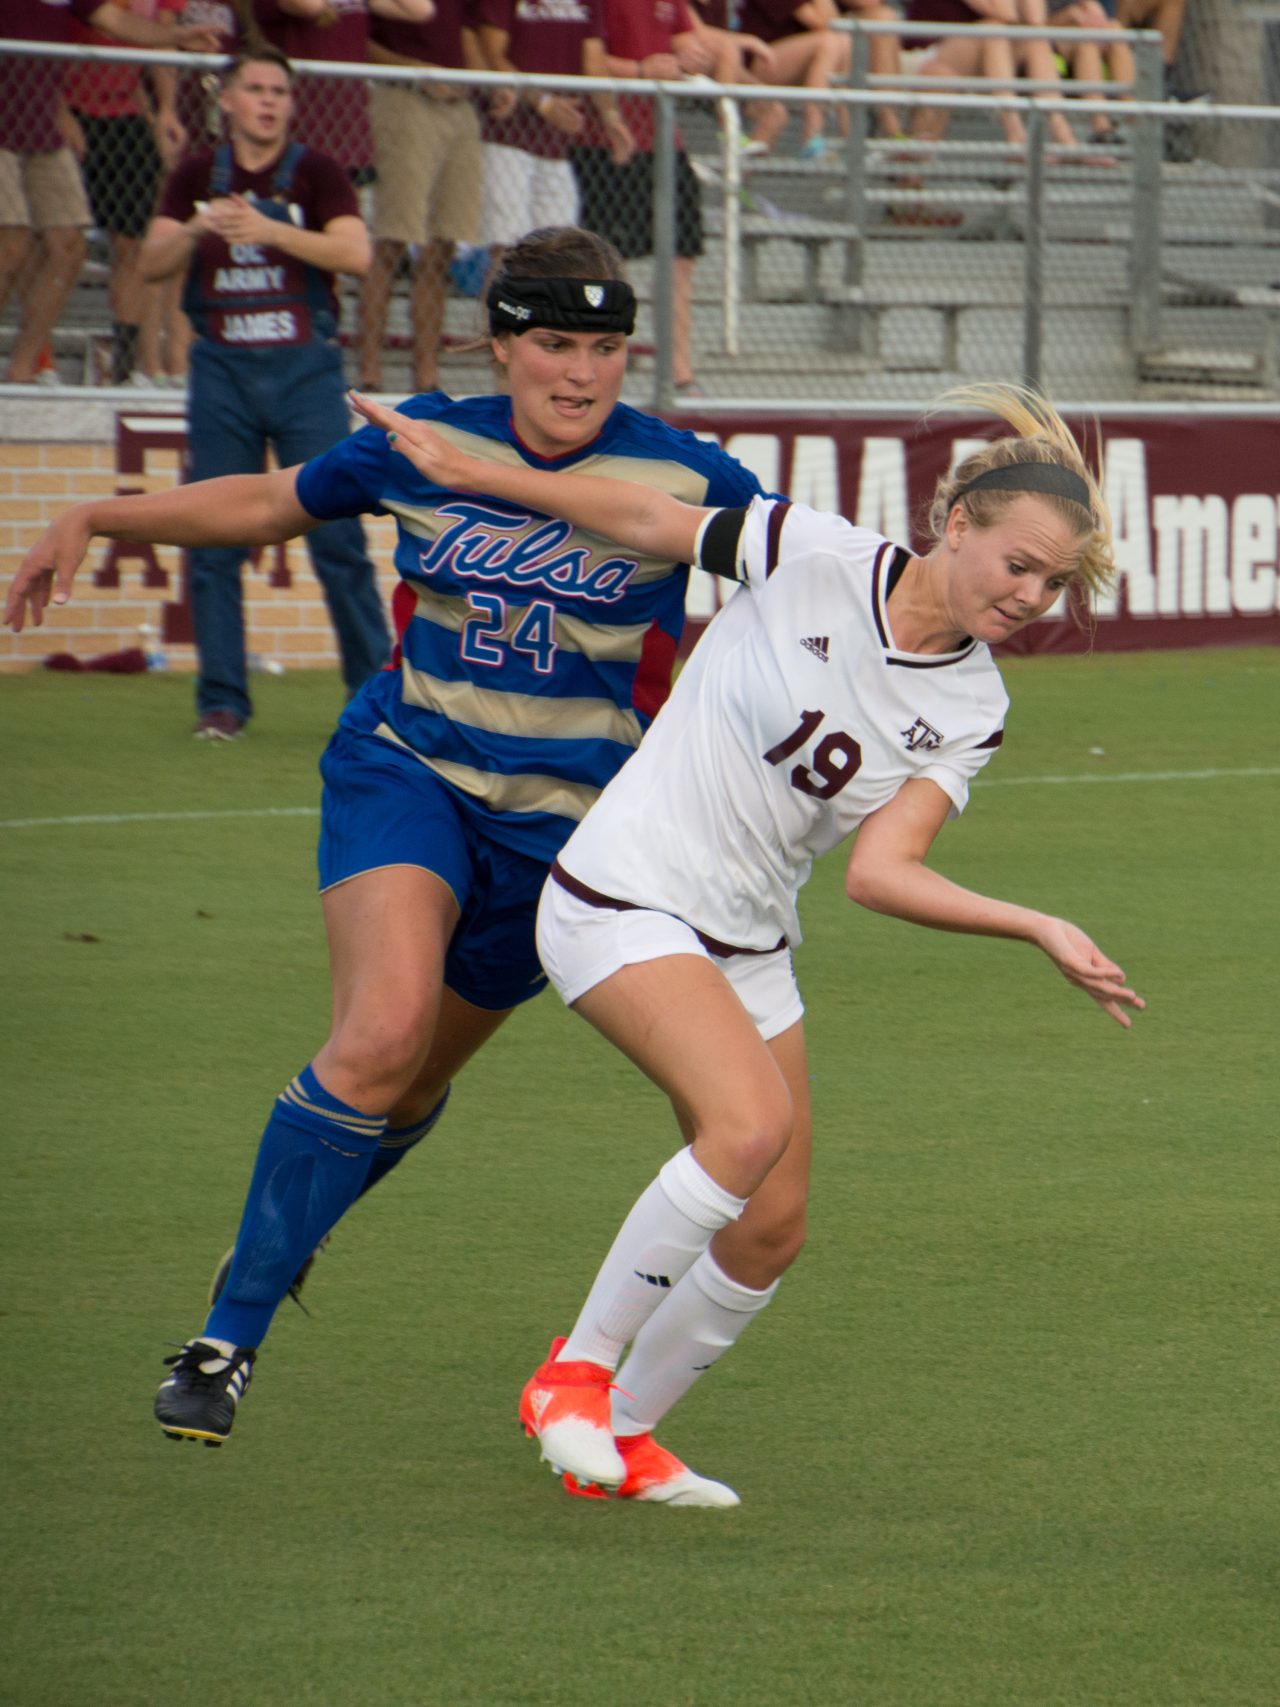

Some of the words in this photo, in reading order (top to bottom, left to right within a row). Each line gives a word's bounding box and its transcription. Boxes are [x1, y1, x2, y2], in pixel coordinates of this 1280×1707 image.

[214, 266, 285, 291] ARMY
[221, 311, 297, 342] JAMES
[420, 502, 639, 603] Tulsa
[461, 591, 559, 674] 24
[800, 638, 829, 663] adidas
[762, 709, 863, 801] 19
